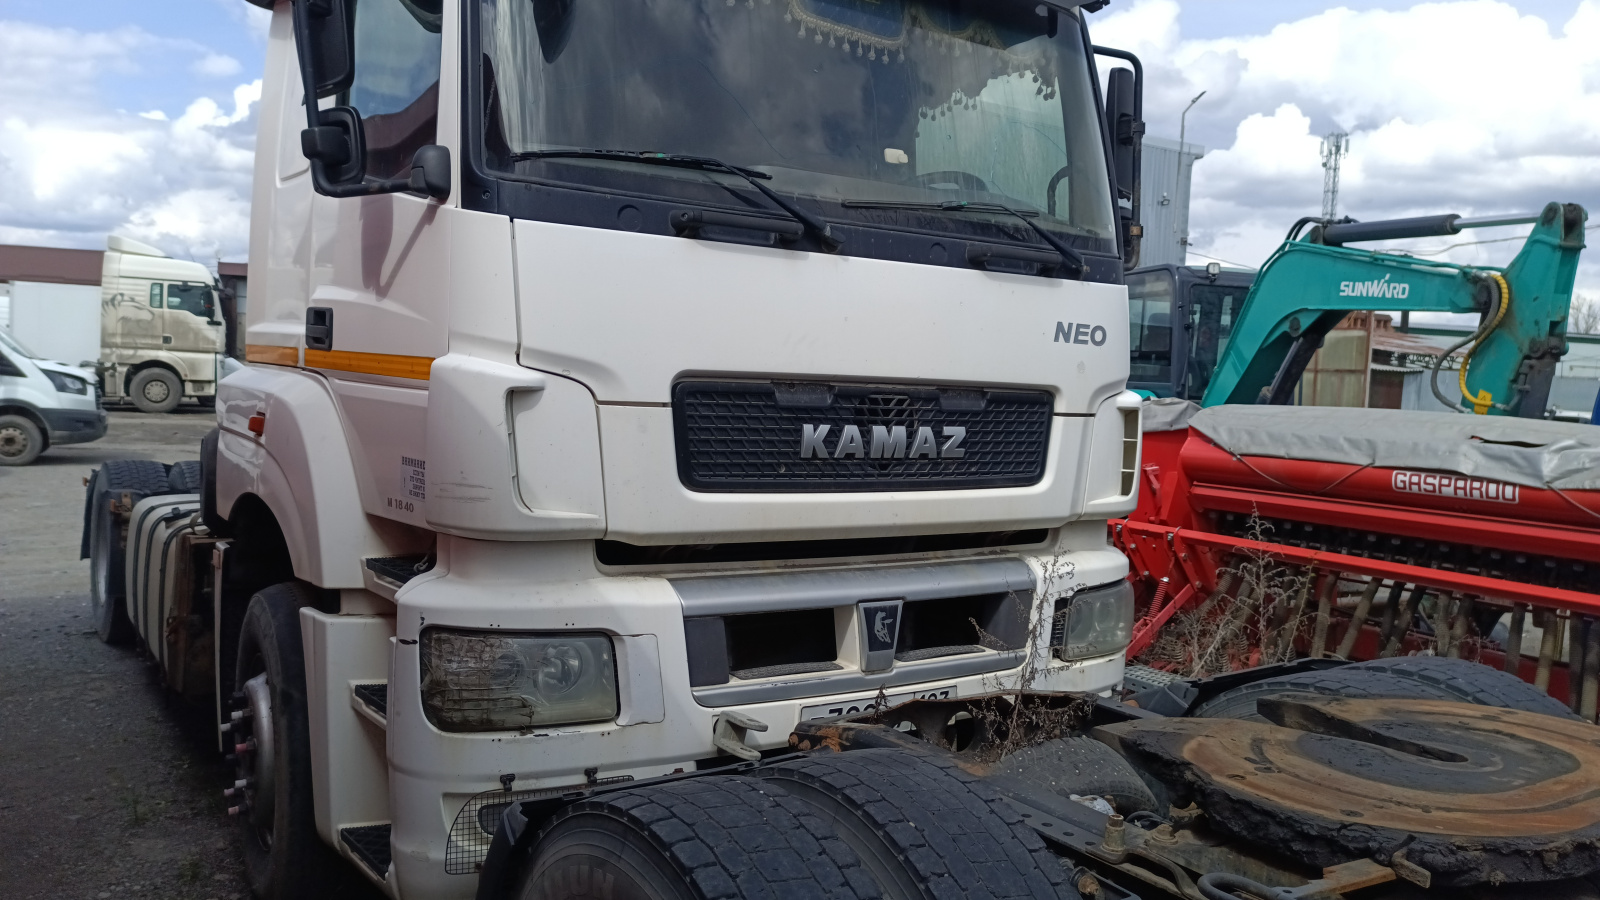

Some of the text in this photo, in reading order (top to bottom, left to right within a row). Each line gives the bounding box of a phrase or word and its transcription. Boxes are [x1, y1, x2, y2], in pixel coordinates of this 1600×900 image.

[1339, 273, 1409, 299] SUNWARD
[1053, 321, 1107, 347] NEO
[800, 423, 967, 459] KAMAZ
[1393, 471, 1518, 502] GASPARDO
